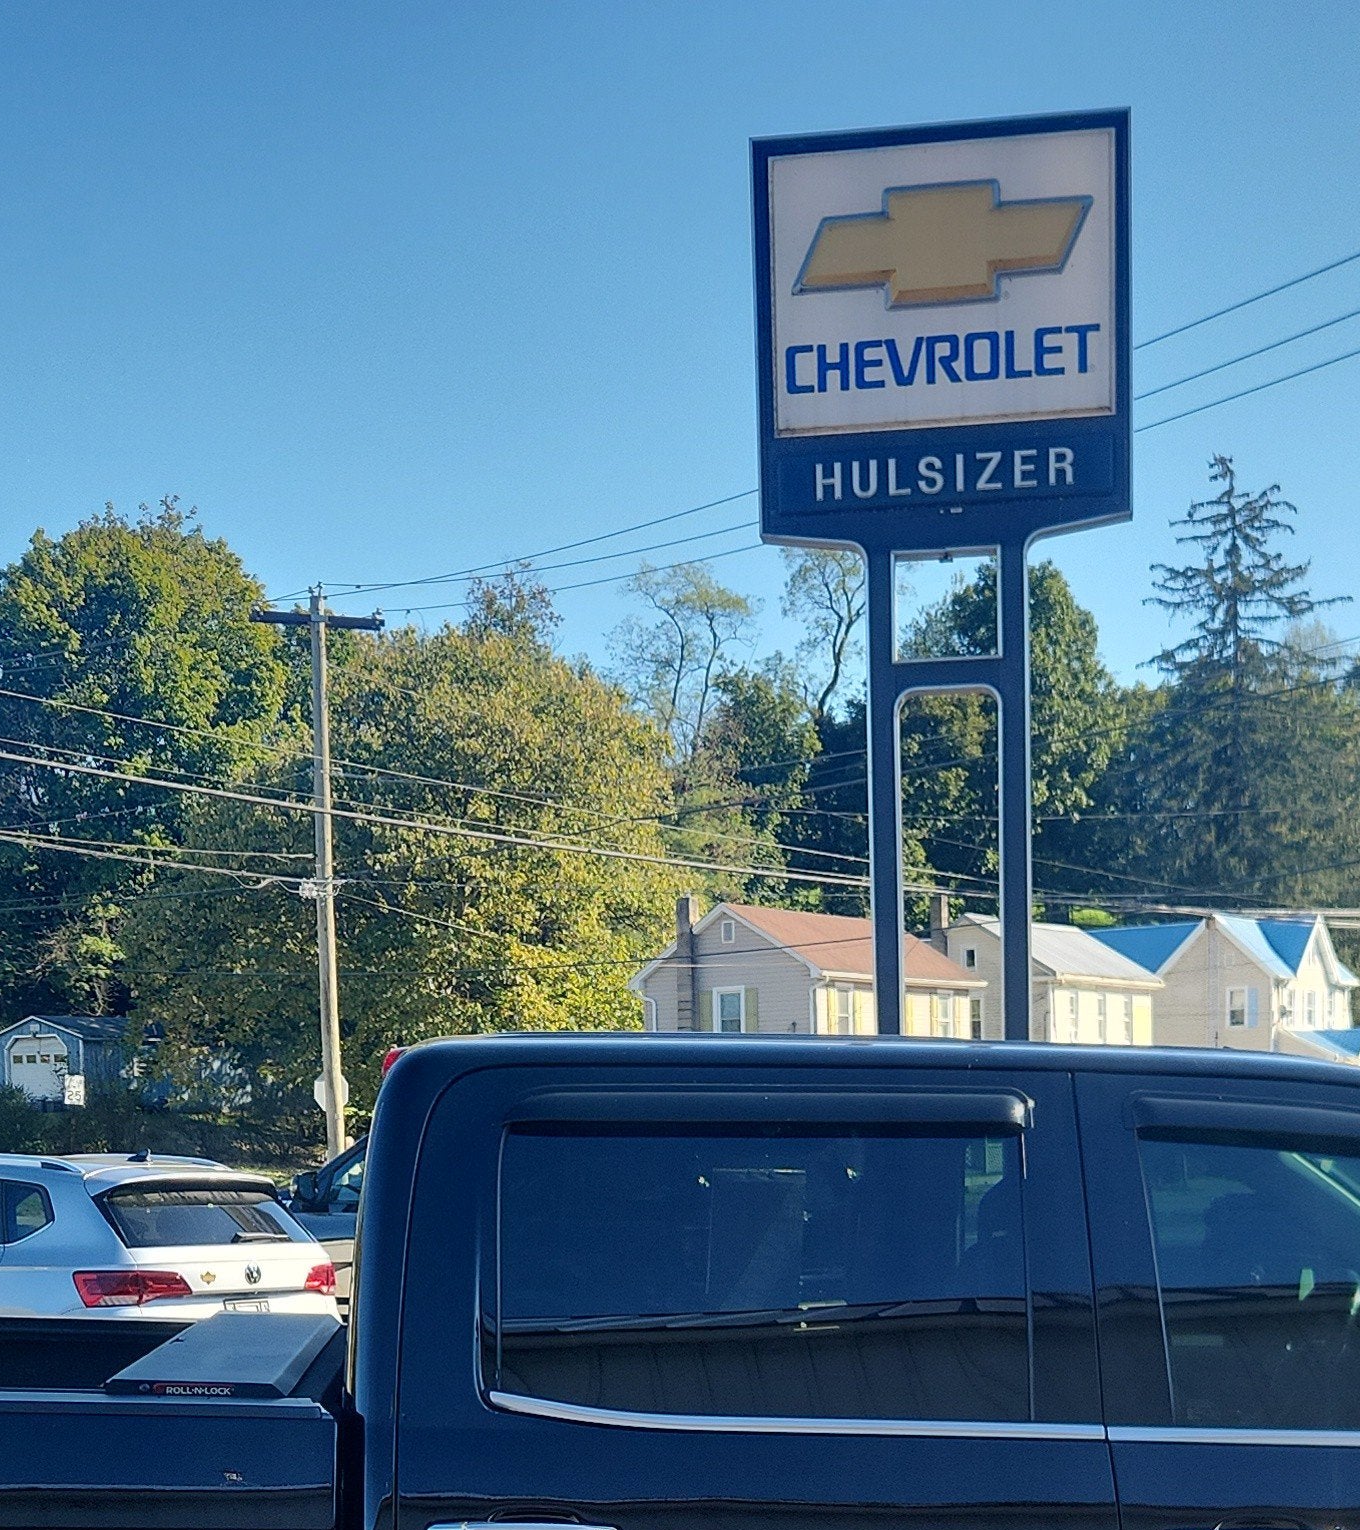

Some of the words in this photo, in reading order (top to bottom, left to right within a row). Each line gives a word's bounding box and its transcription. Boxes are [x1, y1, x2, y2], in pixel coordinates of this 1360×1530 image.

[785, 323, 1100, 395] CHEVROLET
[814, 447, 1075, 501] HULSIZER
[67, 1090, 82, 1101] 25
